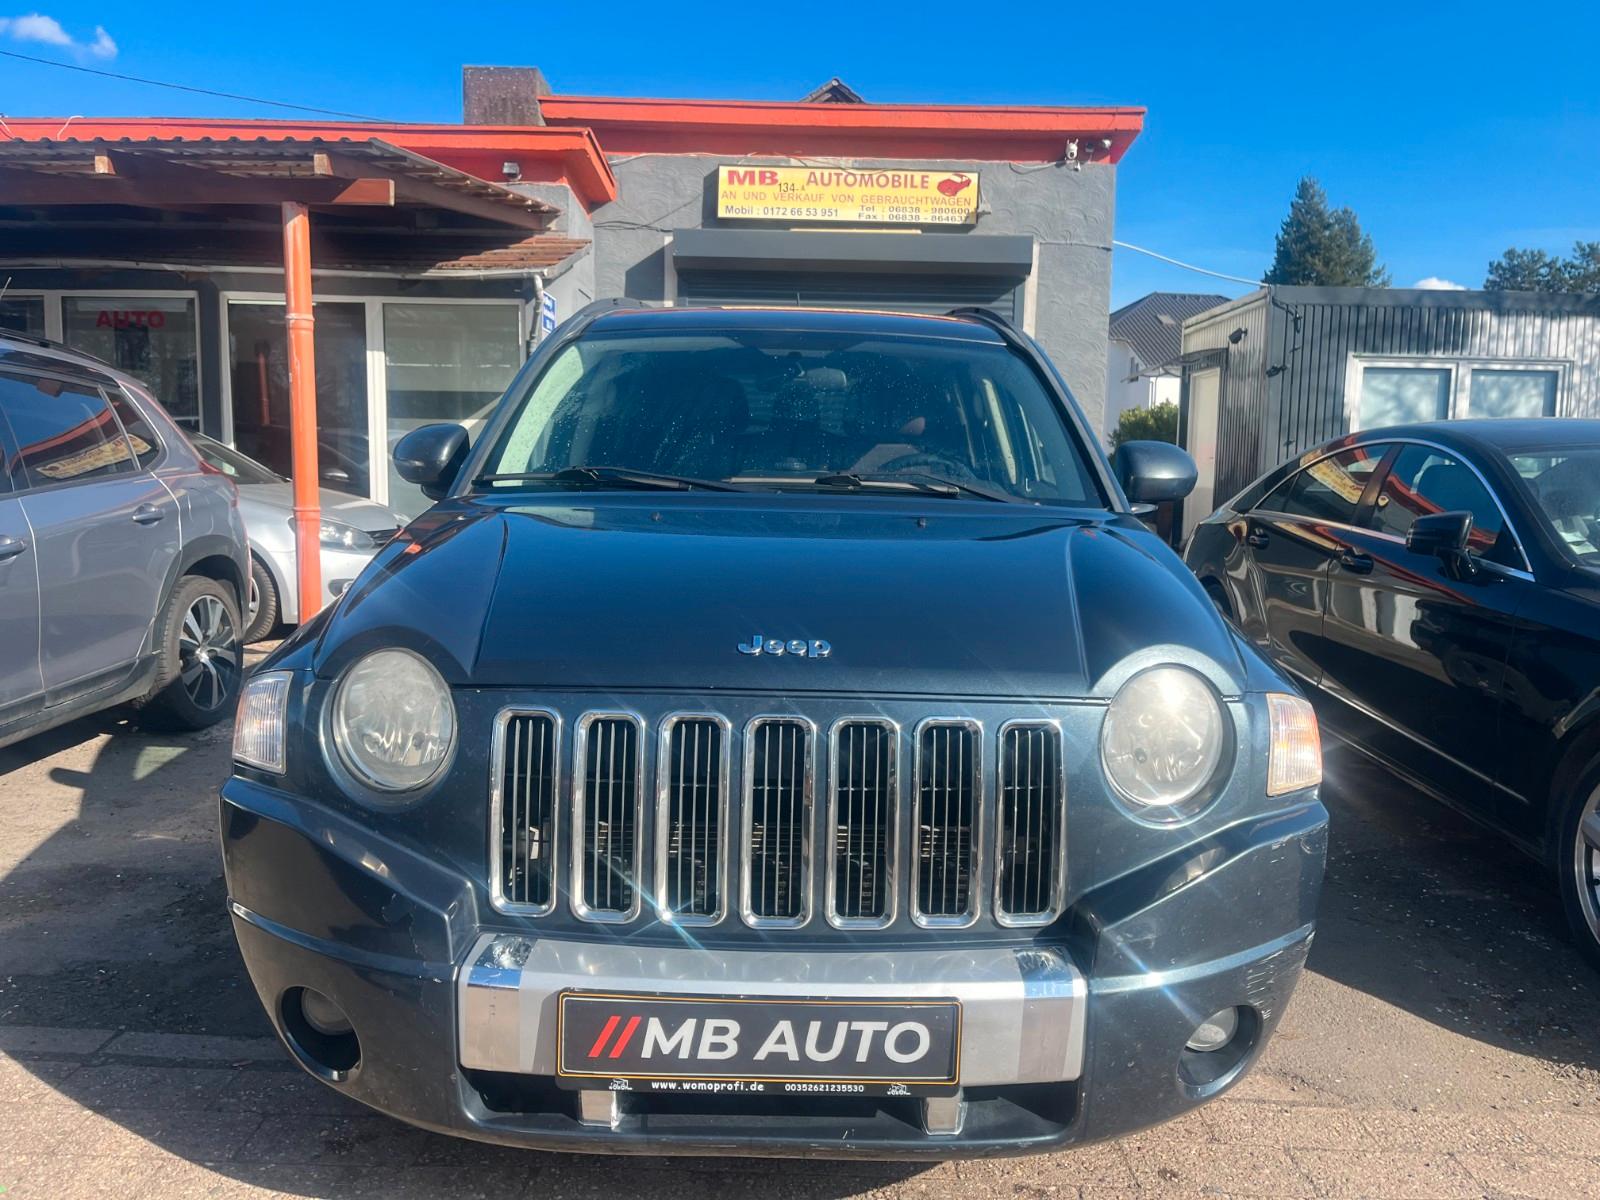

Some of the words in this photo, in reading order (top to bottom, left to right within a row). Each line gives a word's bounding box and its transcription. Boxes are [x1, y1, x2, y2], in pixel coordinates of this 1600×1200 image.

[727, 170, 779, 186] MB
[806, 171, 930, 189] AUTOMOBILE
[721, 191, 737, 200] AN
[743, 191, 767, 201] UND
[773, 192, 825, 202] VERKAUF
[831, 194, 855, 203] VON
[861, 195, 971, 206] GEBRAUCHTWAGEN
[725, 205, 753, 215] Mobil
[763, 207, 788, 216] 0172
[790, 208, 802, 216] 66
[805, 208, 818, 216] 53
[821, 209, 839, 217] 951
[96, 310, 166, 328] AUTO
[738, 635, 831, 657] Jeep
[753, 1020, 930, 1063] AUTO
[651, 1081, 765, 1093] www.womoprofi.de
[785, 1084, 865, 1092] 00352621235530
